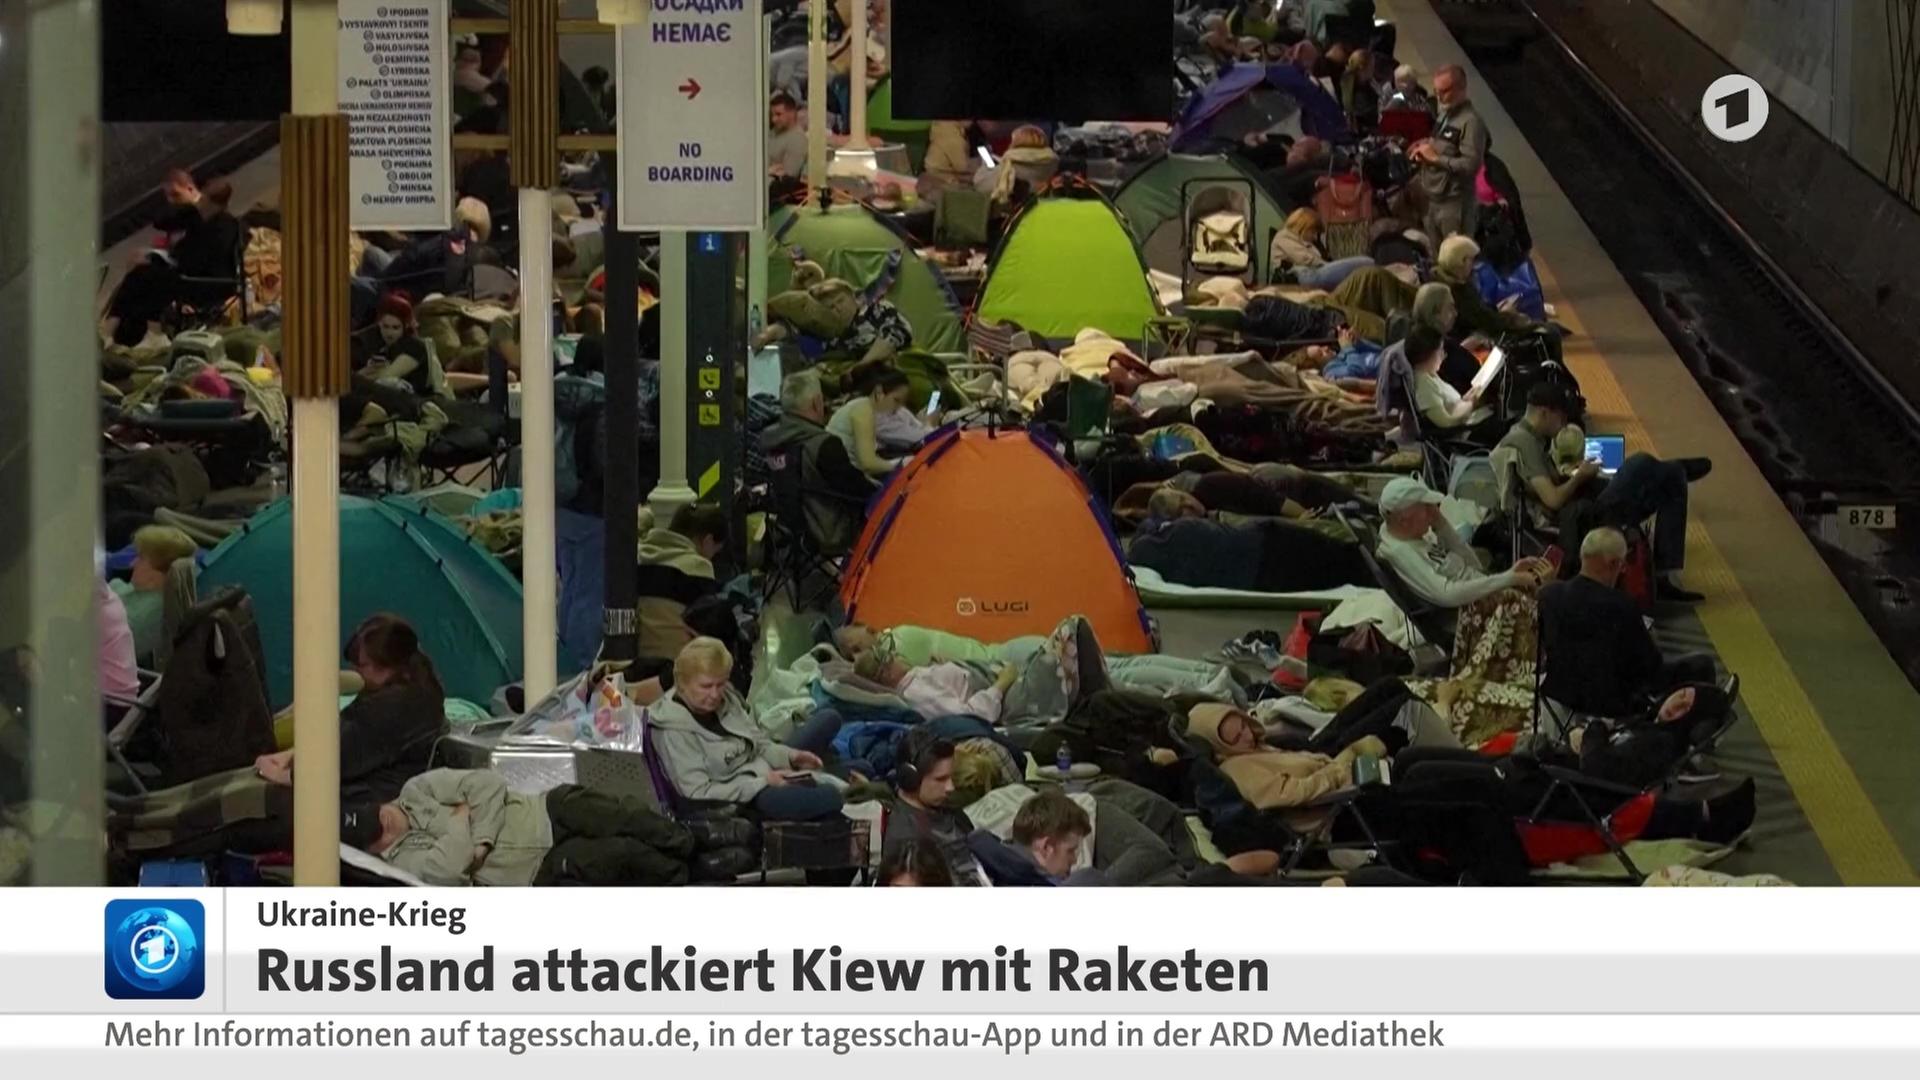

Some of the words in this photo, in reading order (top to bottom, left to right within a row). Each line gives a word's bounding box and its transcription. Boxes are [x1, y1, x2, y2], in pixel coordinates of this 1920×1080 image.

[650, 0, 743, 14] ОСАДКИ
[652, 22, 731, 43] НЕМАЄ
[350, 126, 386, 134] OSHTOVA
[350, 138, 386, 146] RAKTOVA
[350, 149, 376, 157] ARASA
[679, 142, 702, 158] NO
[648, 166, 734, 182] BOARDING
[1849, 509, 1884, 525] 878
[981, 601, 1029, 612] LUGI
